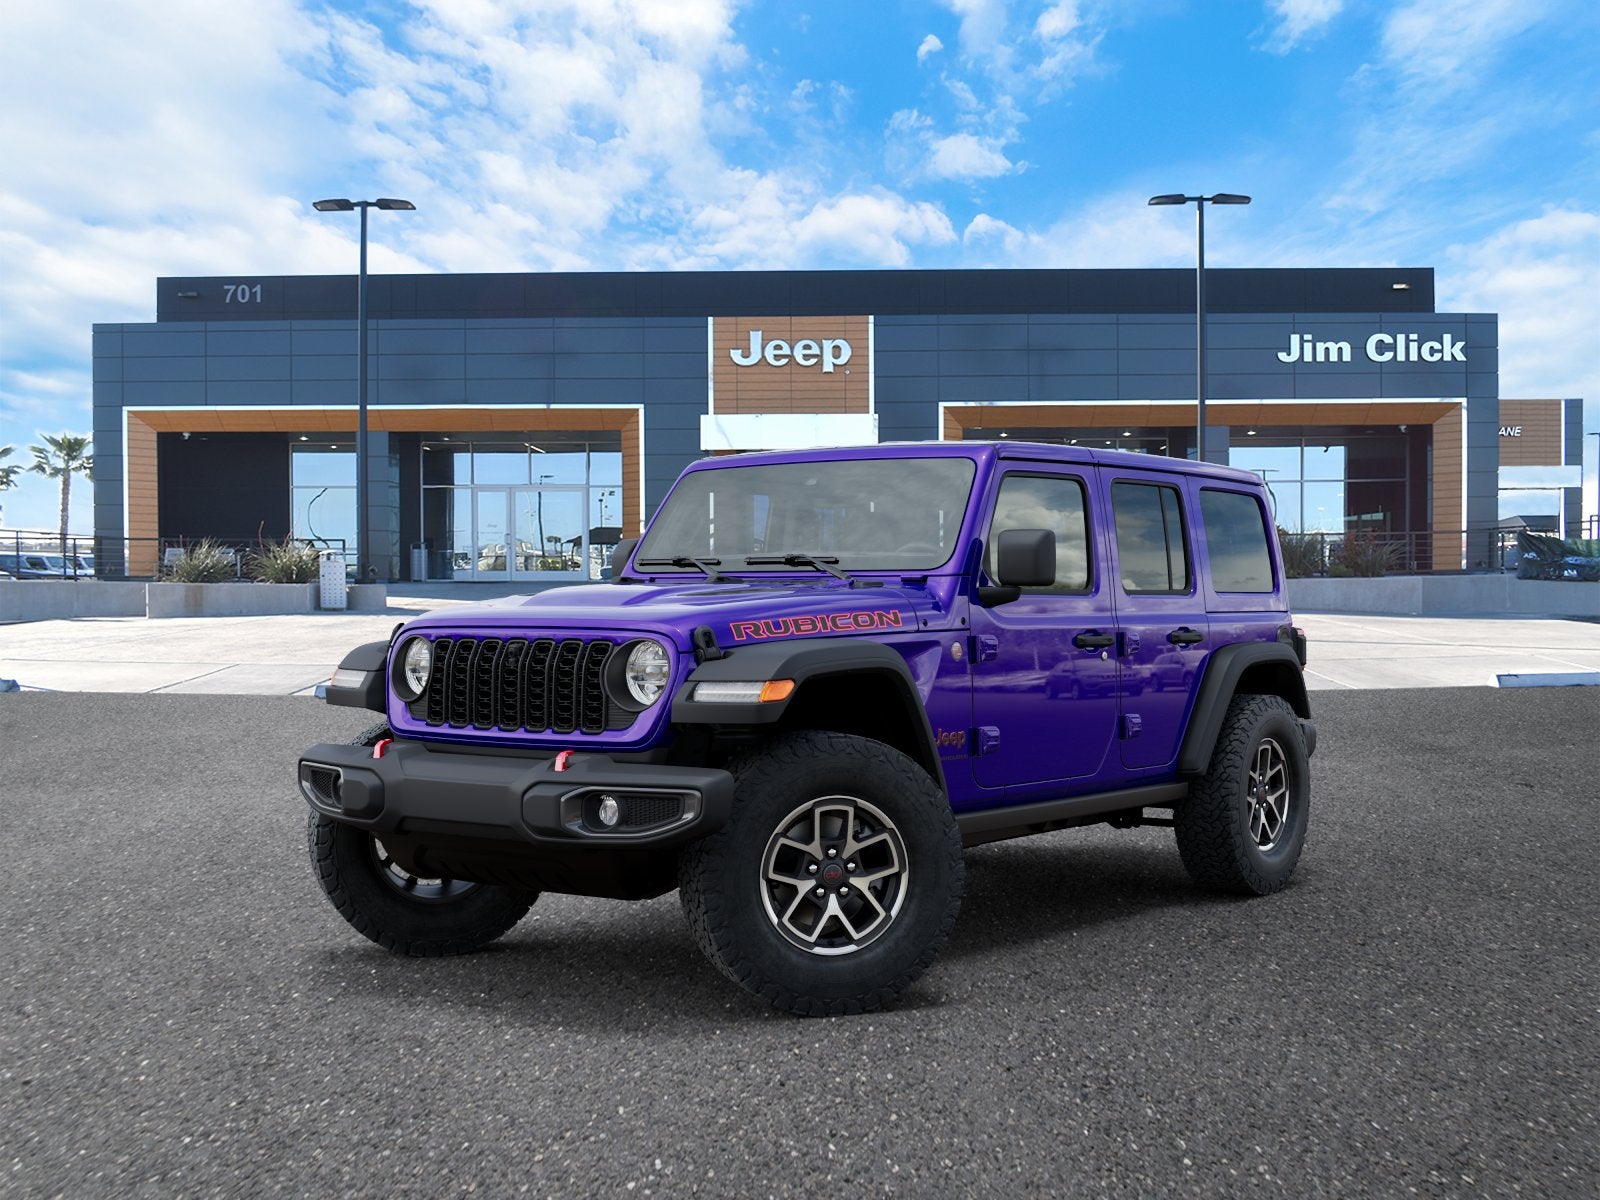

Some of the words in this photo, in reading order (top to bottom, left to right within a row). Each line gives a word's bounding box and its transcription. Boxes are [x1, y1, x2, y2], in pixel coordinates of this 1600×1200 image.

[223, 284, 262, 303] 701
[729, 330, 852, 373] Jeep
[1277, 334, 1351, 363] Jim
[1366, 333, 1467, 362] Click
[730, 610, 902, 640] RUBICON
[934, 728, 966, 749] Jeep
